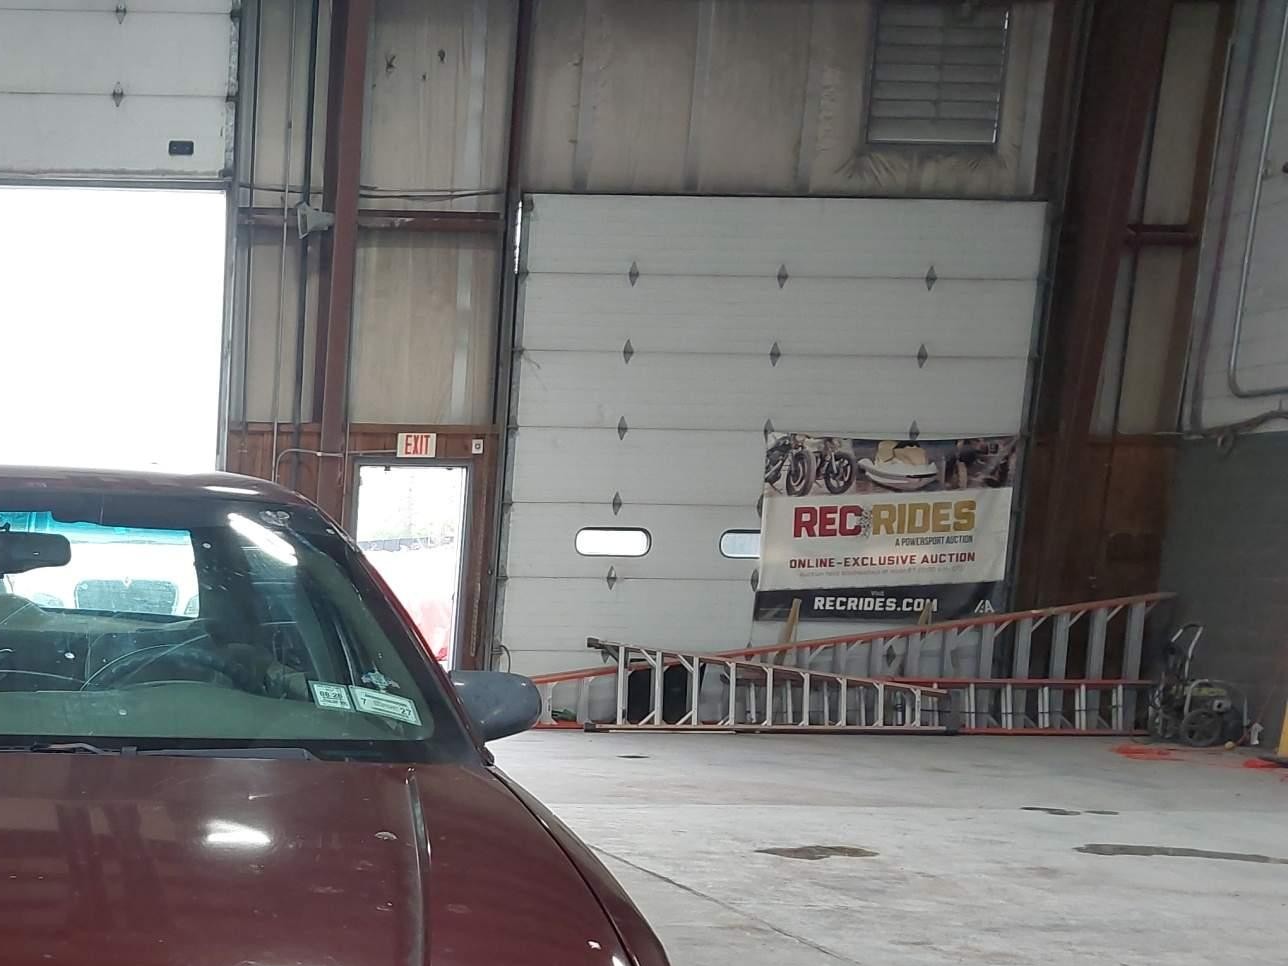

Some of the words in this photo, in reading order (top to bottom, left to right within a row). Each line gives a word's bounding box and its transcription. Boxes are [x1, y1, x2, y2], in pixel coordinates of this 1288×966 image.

[404, 434, 431, 455] EXIT
[793, 504, 864, 538] REC
[871, 499, 977, 536] RIDES
[894, 538, 901, 546] A
[901, 536, 945, 546] POWERSPORT
[945, 535, 974, 545] AUCTION
[789, 555, 918, 569] ONLINE-EXCLUSIVE
[920, 551, 976, 565] AUCTION
[813, 596, 938, 612] RECRIDES.COM
